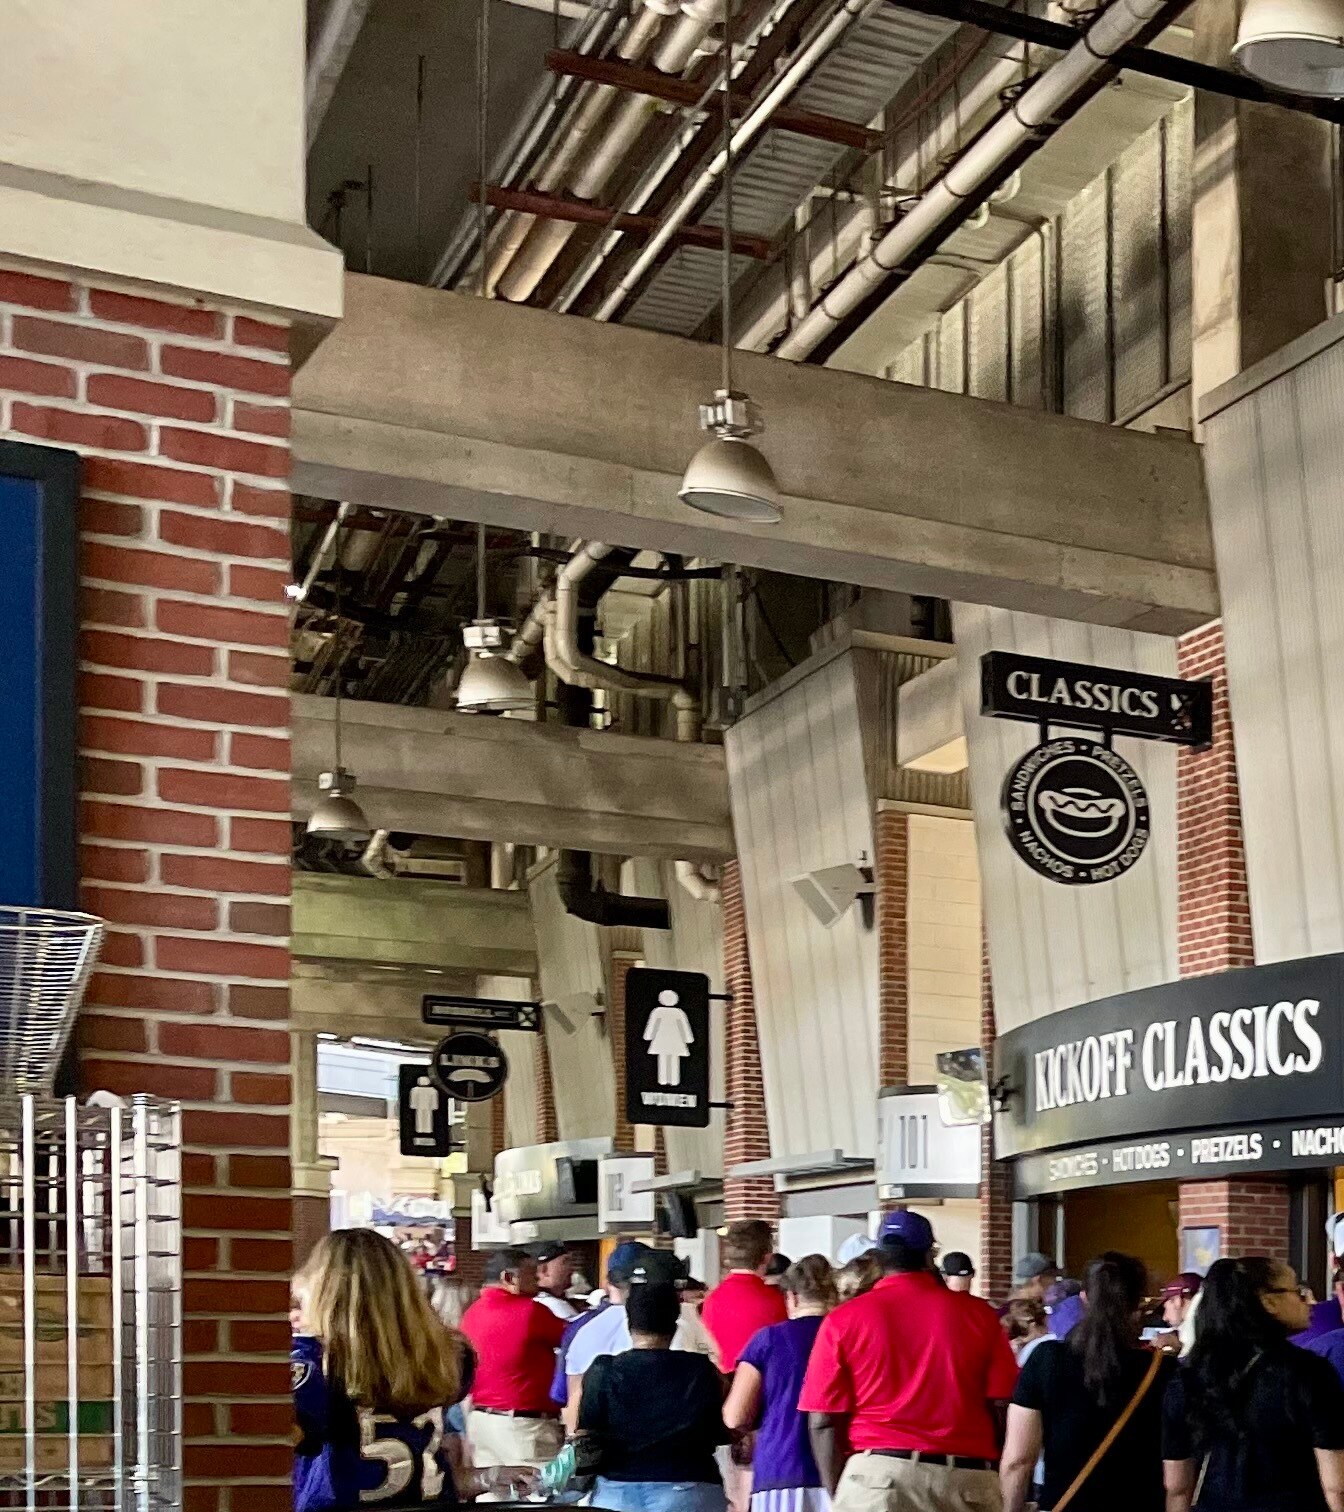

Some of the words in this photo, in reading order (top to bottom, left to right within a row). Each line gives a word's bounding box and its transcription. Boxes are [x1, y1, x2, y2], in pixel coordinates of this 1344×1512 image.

[1006, 670, 1160, 718] CLASSICS
[1018, 830, 1075, 878] NACHOS
[1091, 860, 1122, 880] HOT
[1034, 1028, 1134, 1112] KICKOFF
[1142, 998, 1323, 1092] CLASSICS
[1191, 1133, 1263, 1164] PRETZELS
